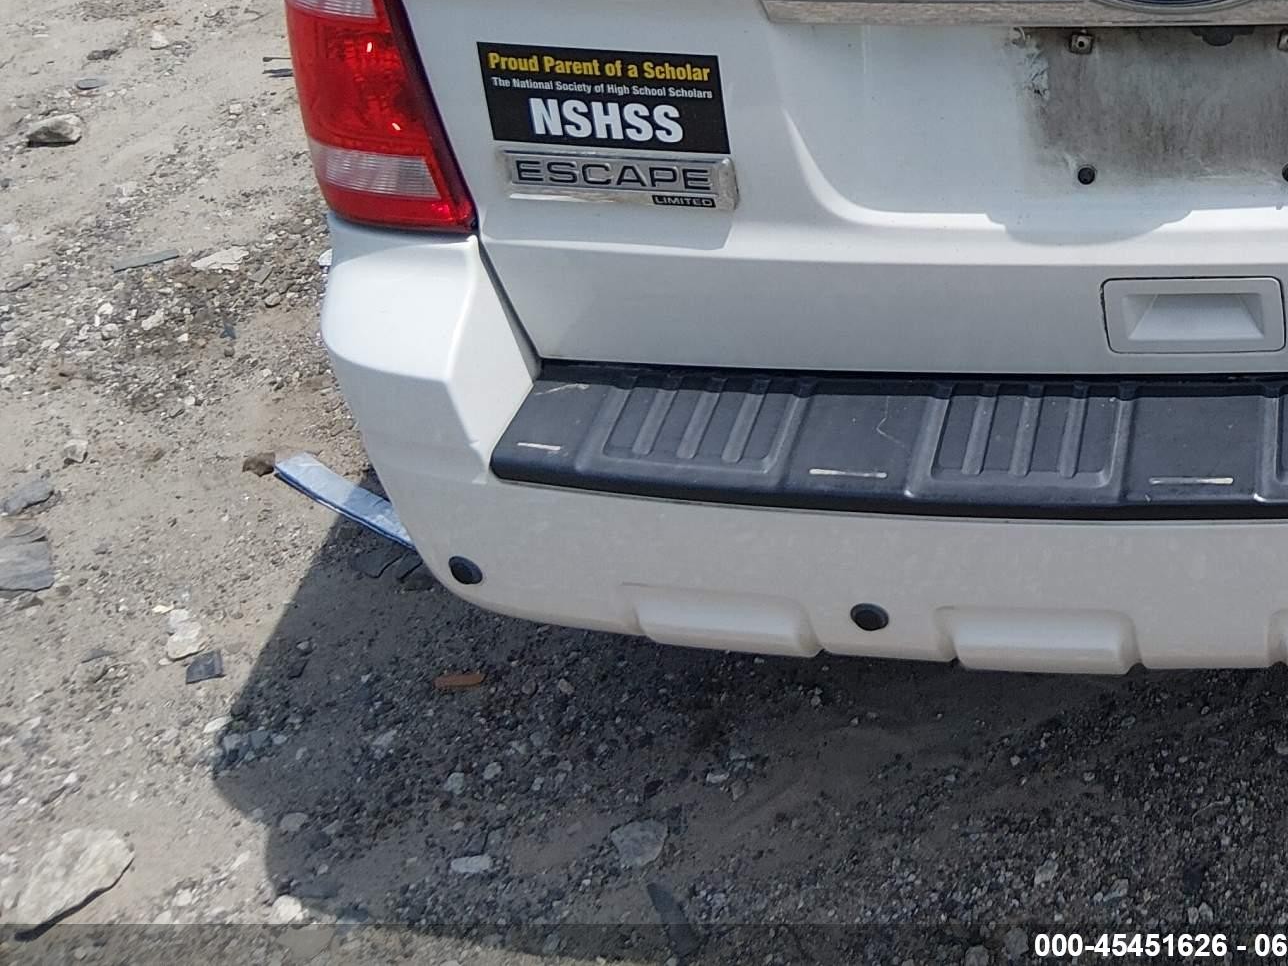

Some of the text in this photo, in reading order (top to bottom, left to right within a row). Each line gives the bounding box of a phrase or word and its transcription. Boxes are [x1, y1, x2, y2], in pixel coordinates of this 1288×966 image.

[488, 52, 711, 81] Proud Parent of a Scholar
[491, 76, 713, 99] The National Society of High School Scholars
[529, 97, 684, 143] NSHSS
[515, 159, 712, 191] ESCAPE
[654, 195, 714, 208] LIMITED
